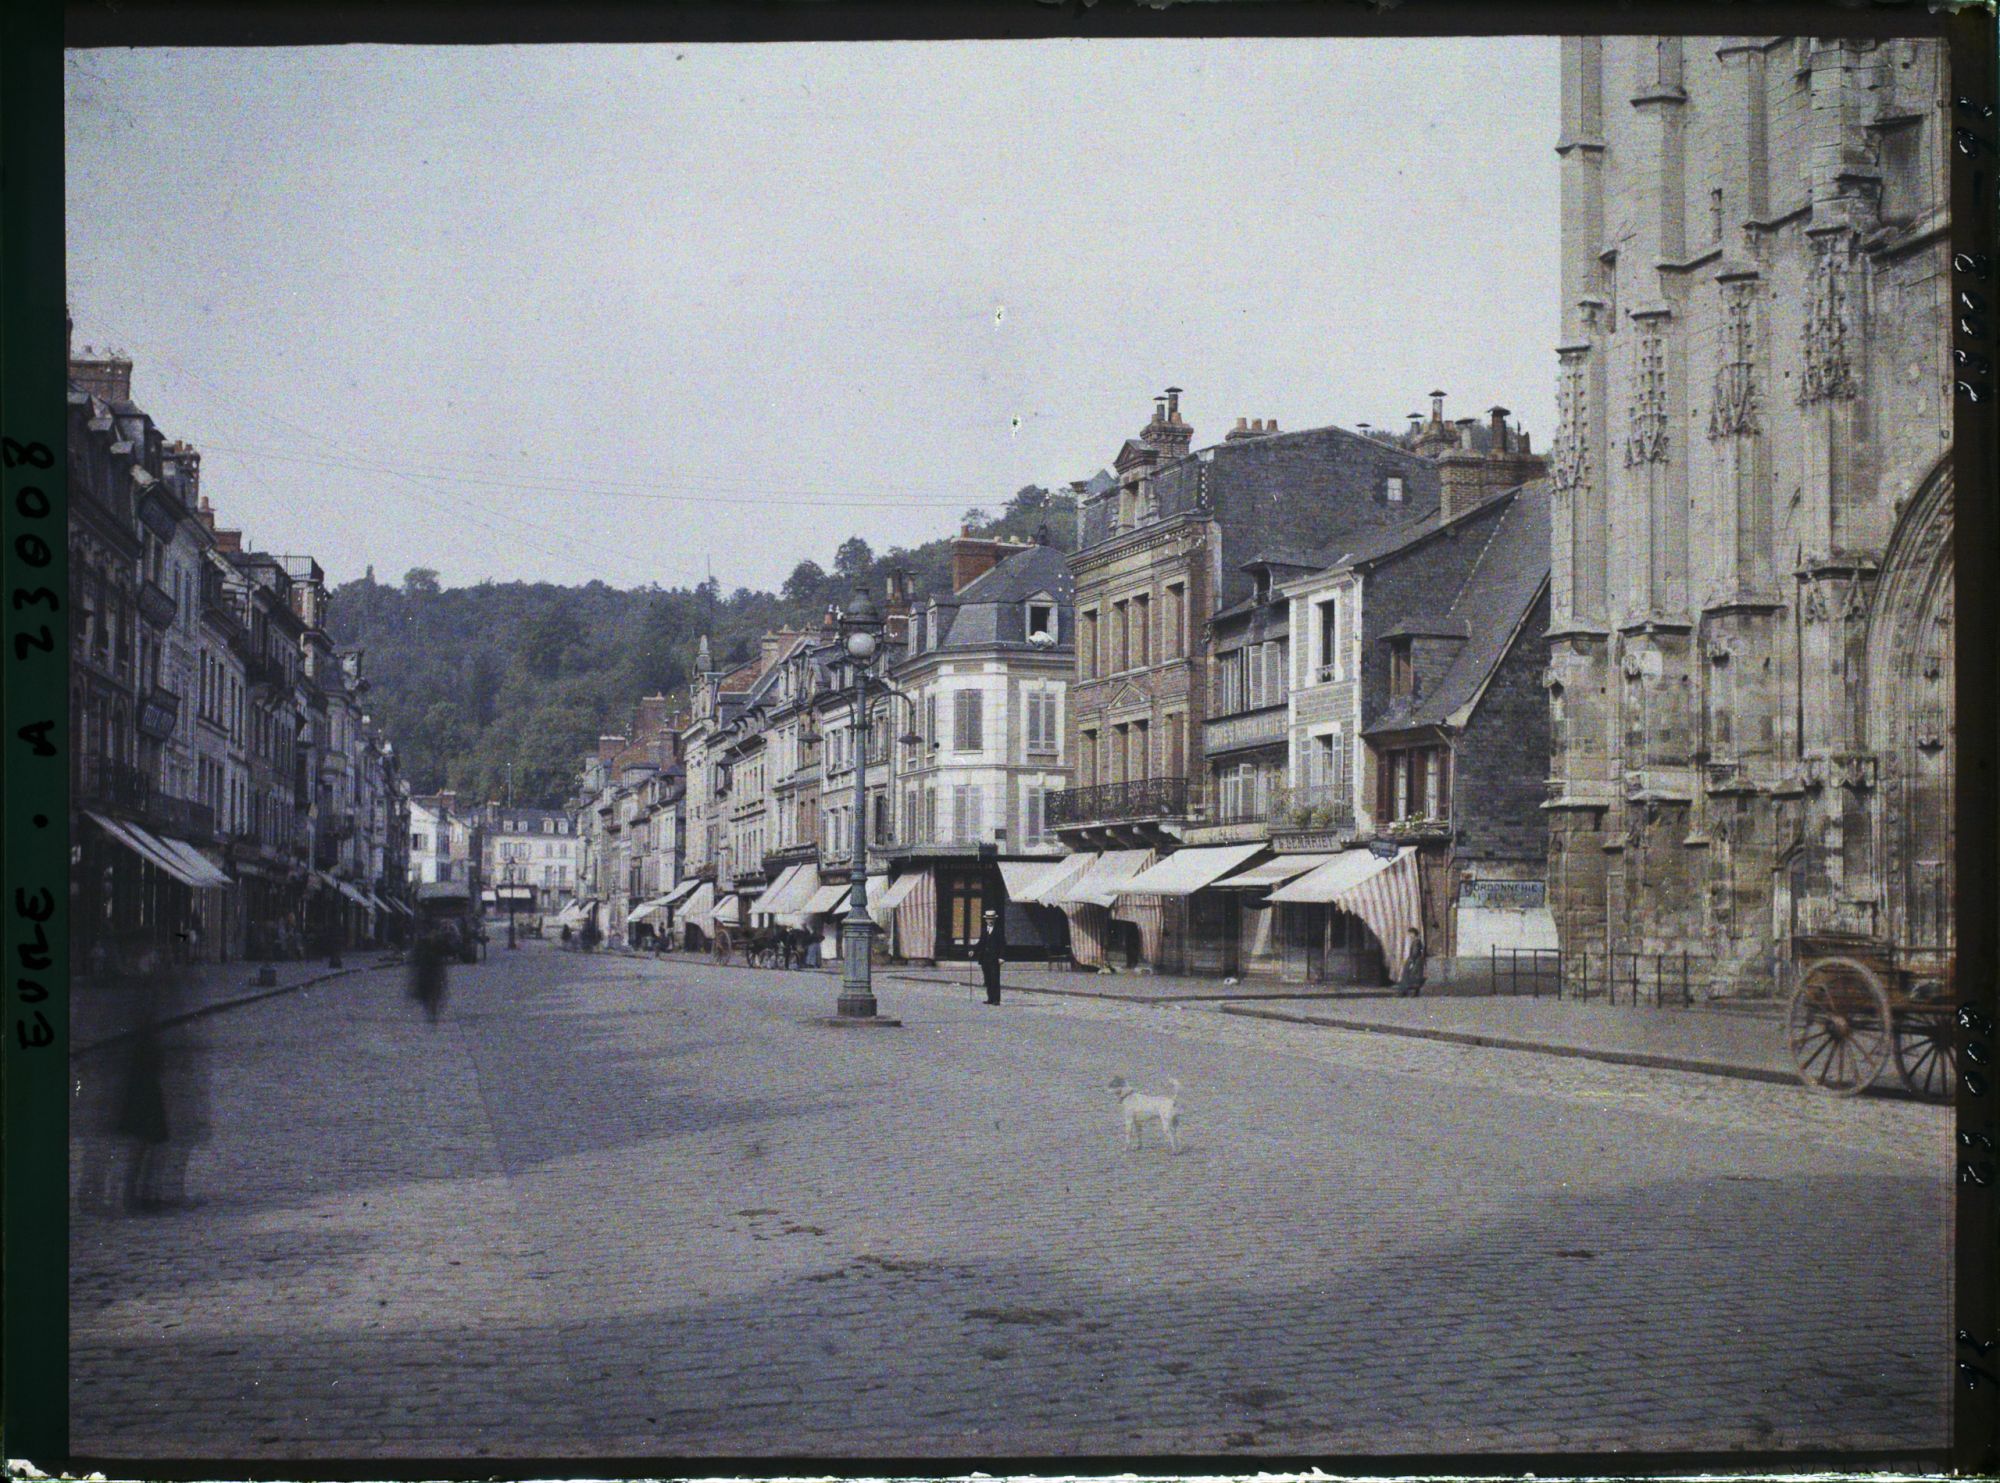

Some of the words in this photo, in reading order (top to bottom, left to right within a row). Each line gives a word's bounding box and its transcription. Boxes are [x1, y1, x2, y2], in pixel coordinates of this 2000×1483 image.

[2, 434, 59, 661] 23008
[17, 719, 57, 758] A
[14, 885, 55, 1049] EURE
